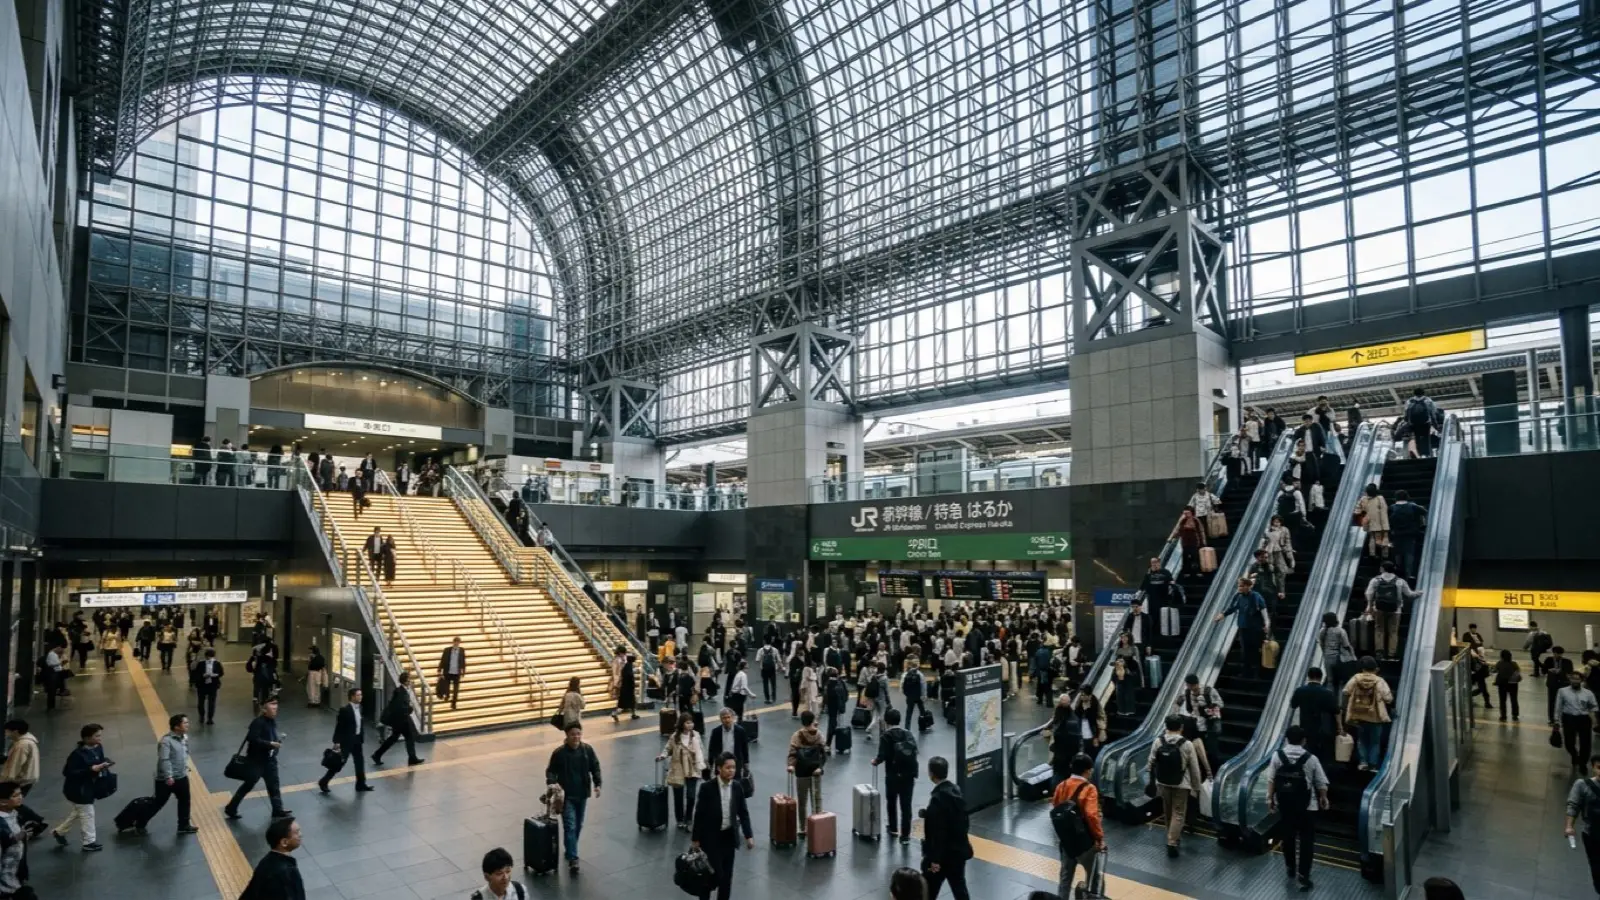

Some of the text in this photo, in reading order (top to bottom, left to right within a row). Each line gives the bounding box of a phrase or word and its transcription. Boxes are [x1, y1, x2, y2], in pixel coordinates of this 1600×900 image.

[851, 506, 879, 528] JR
[967, 500, 1013, 518] はるか
